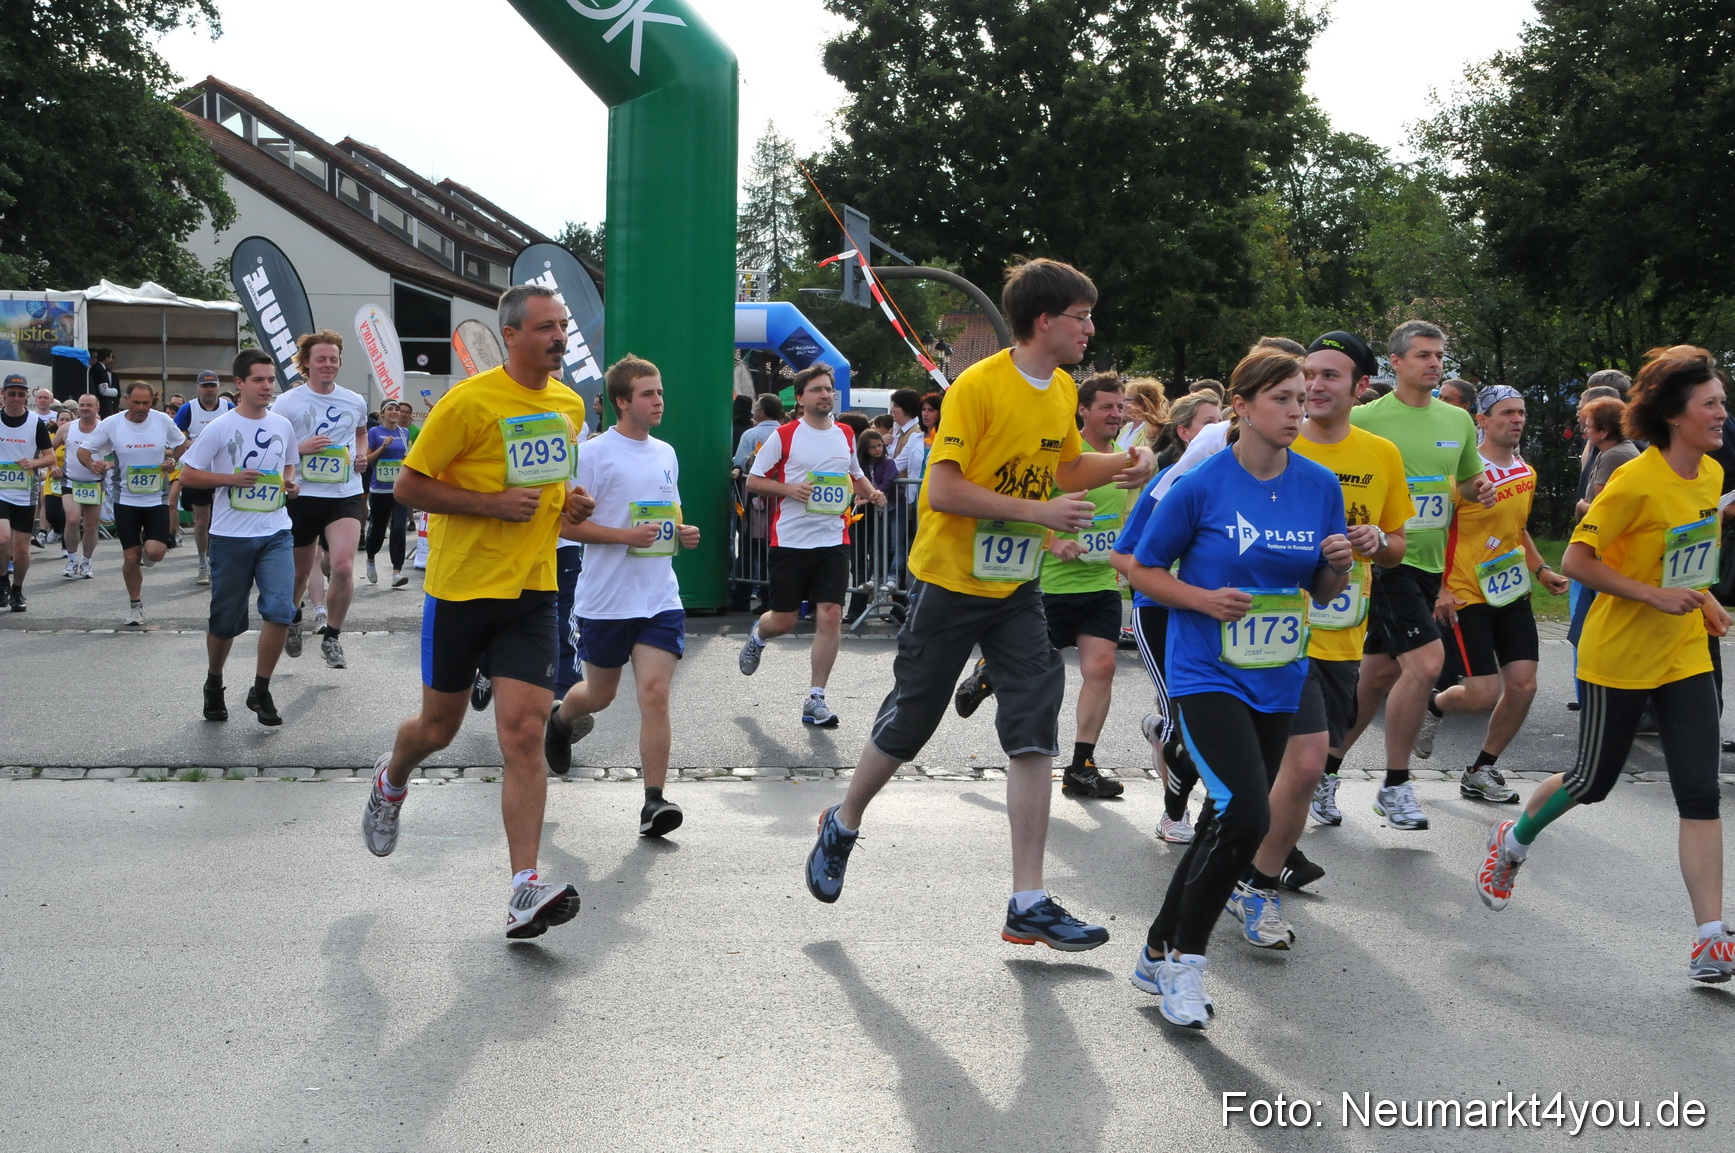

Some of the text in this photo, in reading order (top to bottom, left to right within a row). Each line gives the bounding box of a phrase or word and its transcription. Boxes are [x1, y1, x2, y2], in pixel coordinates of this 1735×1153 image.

[509, 437, 567, 468] 1293
[307, 456, 342, 473] 473
[378, 466, 400, 477] 1311
[518, 468, 541, 477] Thomas
[0, 471, 26, 482] 504
[131, 475, 157, 485] 487
[75, 489, 96, 498] 494
[236, 486, 280, 502] 1347
[812, 486, 844, 503] 869
[1495, 488, 1514, 503] AX
[1415, 496, 1443, 518] 73
[1083, 531, 1116, 553] 369
[1265, 531, 1315, 543] PLAST
[981, 535, 1031, 565] 191
[982, 563, 1010, 572] Sebastian
[1669, 542, 1712, 577] 177
[1487, 566, 1523, 595] 423
[1227, 616, 1299, 647] 1173
[1244, 647, 1263, 657] Josef
